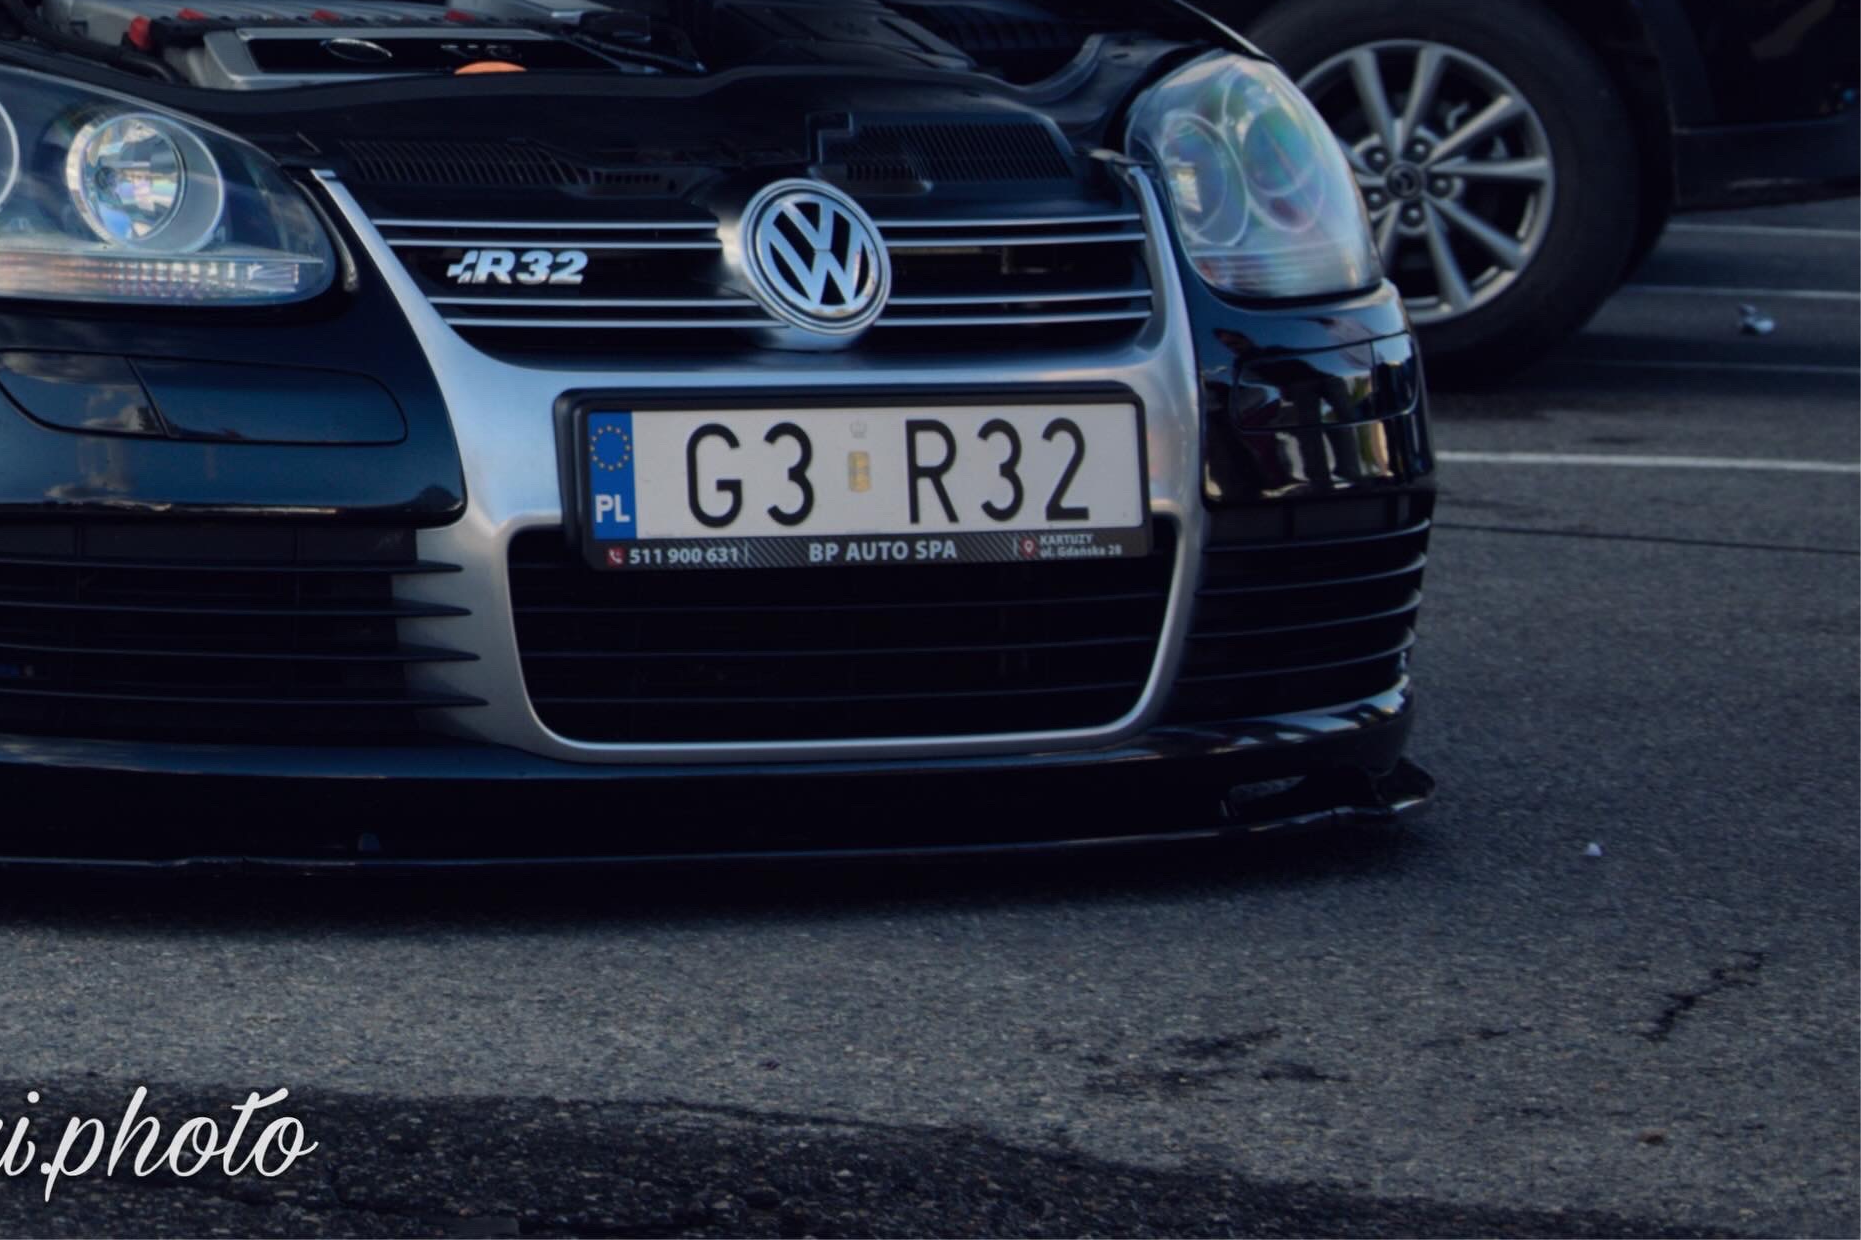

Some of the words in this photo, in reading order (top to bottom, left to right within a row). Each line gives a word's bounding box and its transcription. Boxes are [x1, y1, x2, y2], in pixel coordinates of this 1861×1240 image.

[685, 421, 815, 529] G3
[904, 417, 1091, 526] R32
[594, 494, 630, 524] PL
[809, 543, 839, 562] BP
[845, 540, 910, 561] AUTO
[915, 539, 957, 559] SPA
[1040, 534, 1093, 545] KARTUZY
[629, 547, 662, 565] 511
[668, 546, 704, 564] 900
[706, 546, 739, 564] 631
